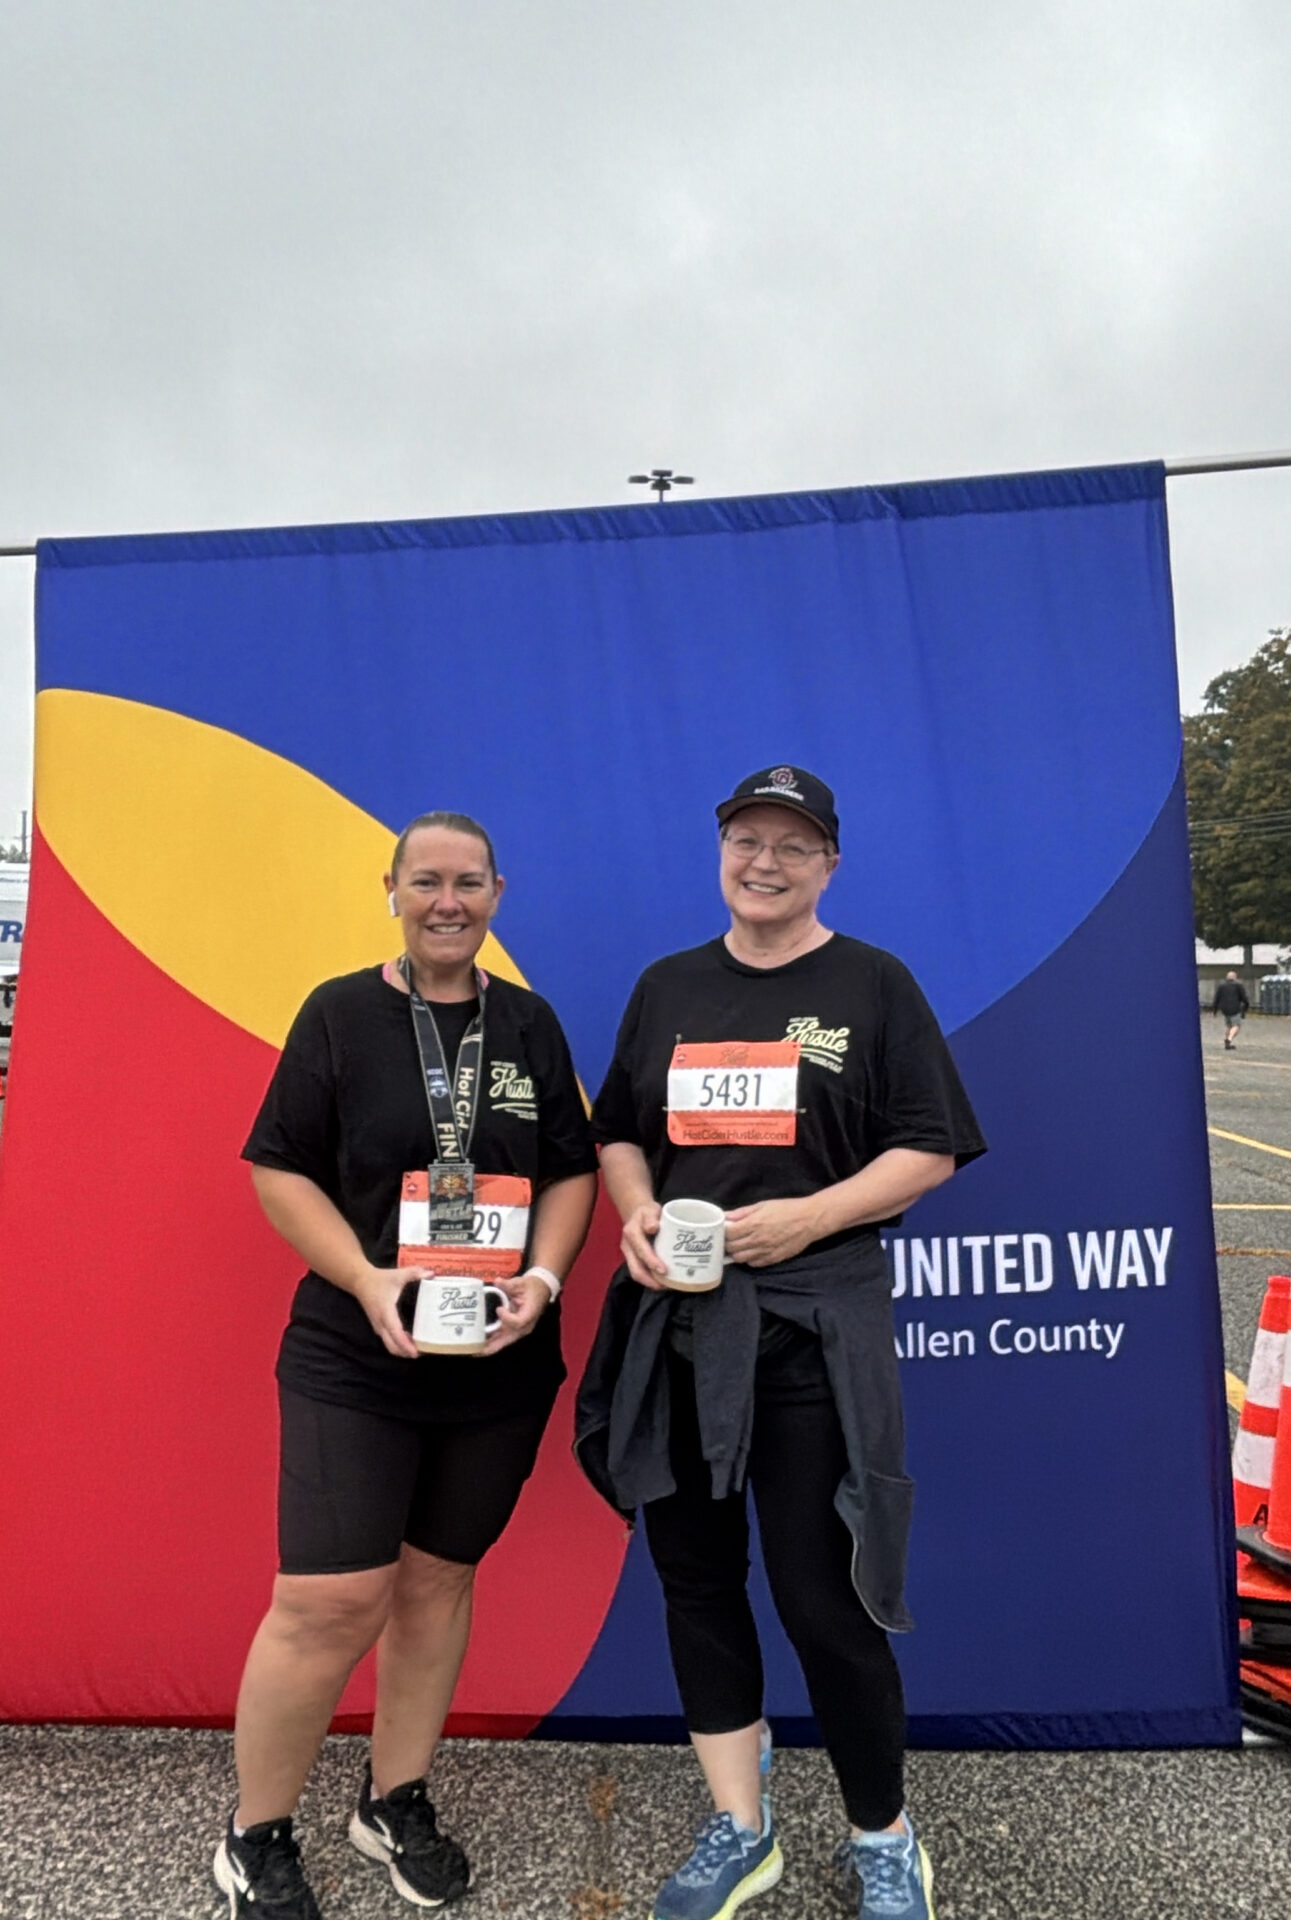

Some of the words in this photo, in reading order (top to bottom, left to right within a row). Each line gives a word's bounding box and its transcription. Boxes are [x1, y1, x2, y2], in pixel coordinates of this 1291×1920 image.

[0, 919, 24, 944] R
[779, 1020, 850, 1053] Hustle
[488, 1067, 535, 1099] Hustl
[699, 1073, 763, 1107] 5431
[455, 1100, 471, 1135] Cid
[1067, 1227, 1174, 1290] WAY
[989, 1318, 1125, 1360] County
